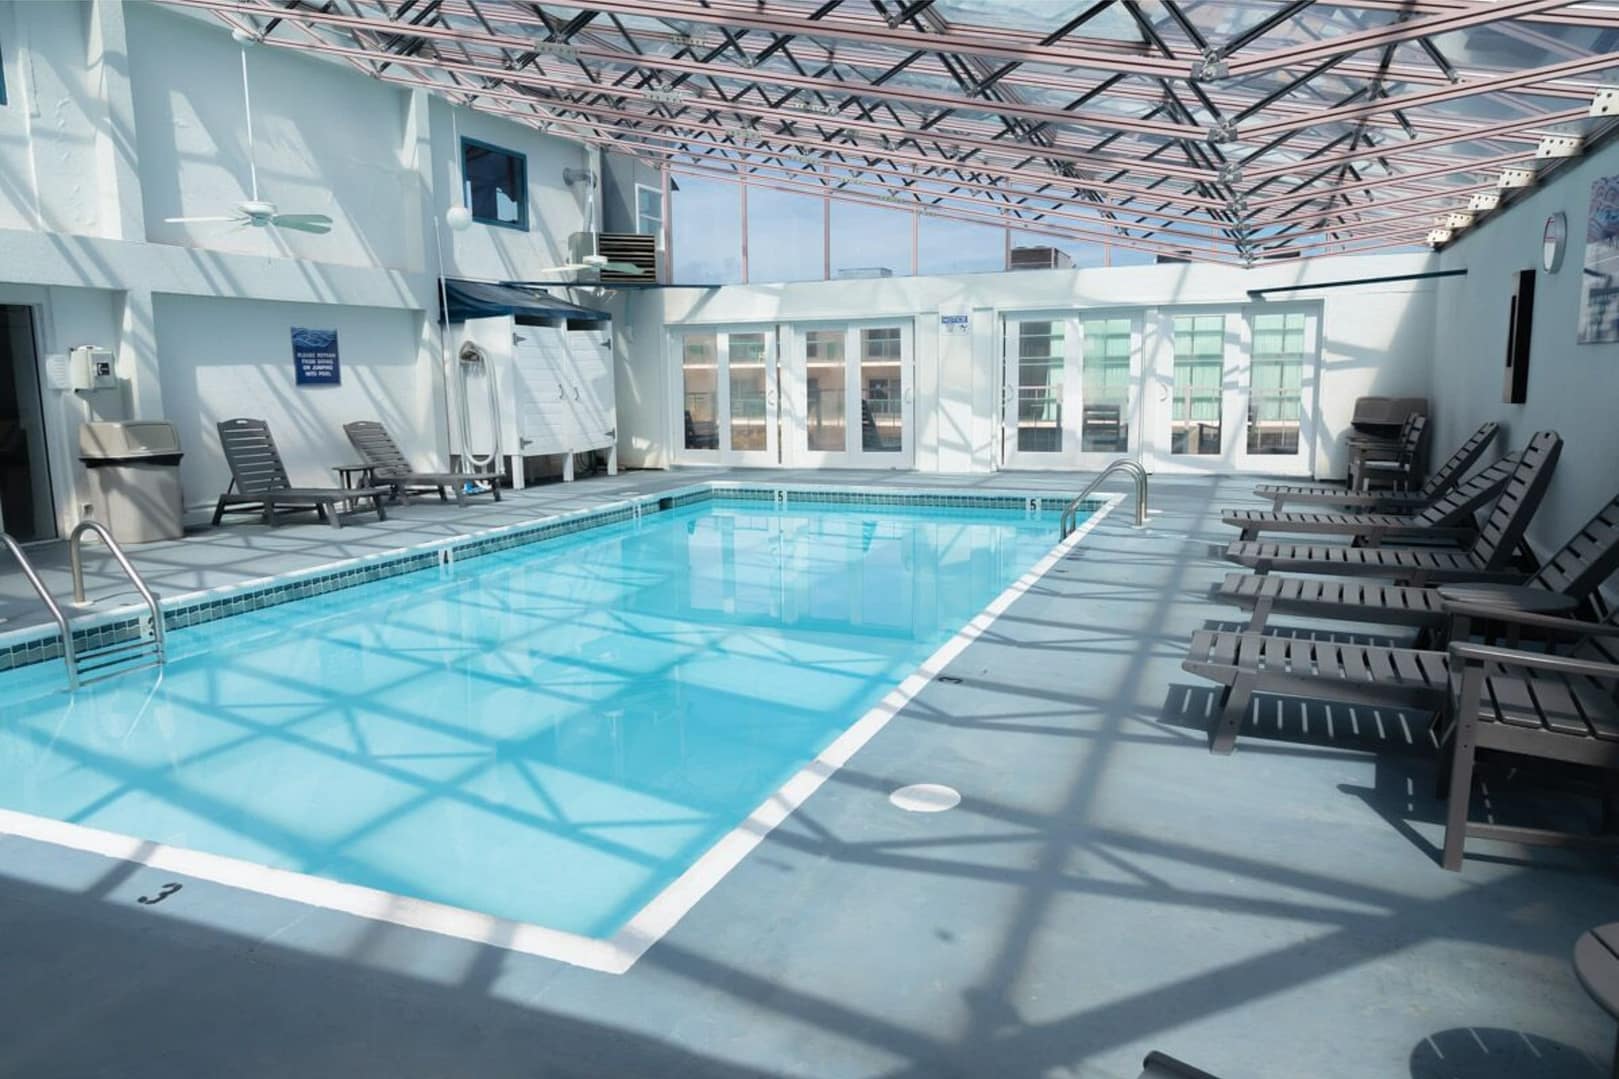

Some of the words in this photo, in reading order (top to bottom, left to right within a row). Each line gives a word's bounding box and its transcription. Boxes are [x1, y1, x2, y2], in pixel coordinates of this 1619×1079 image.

[778, 490, 784, 501] 5
[1030, 498, 1037, 511] 5
[137, 882, 183, 905] 3
